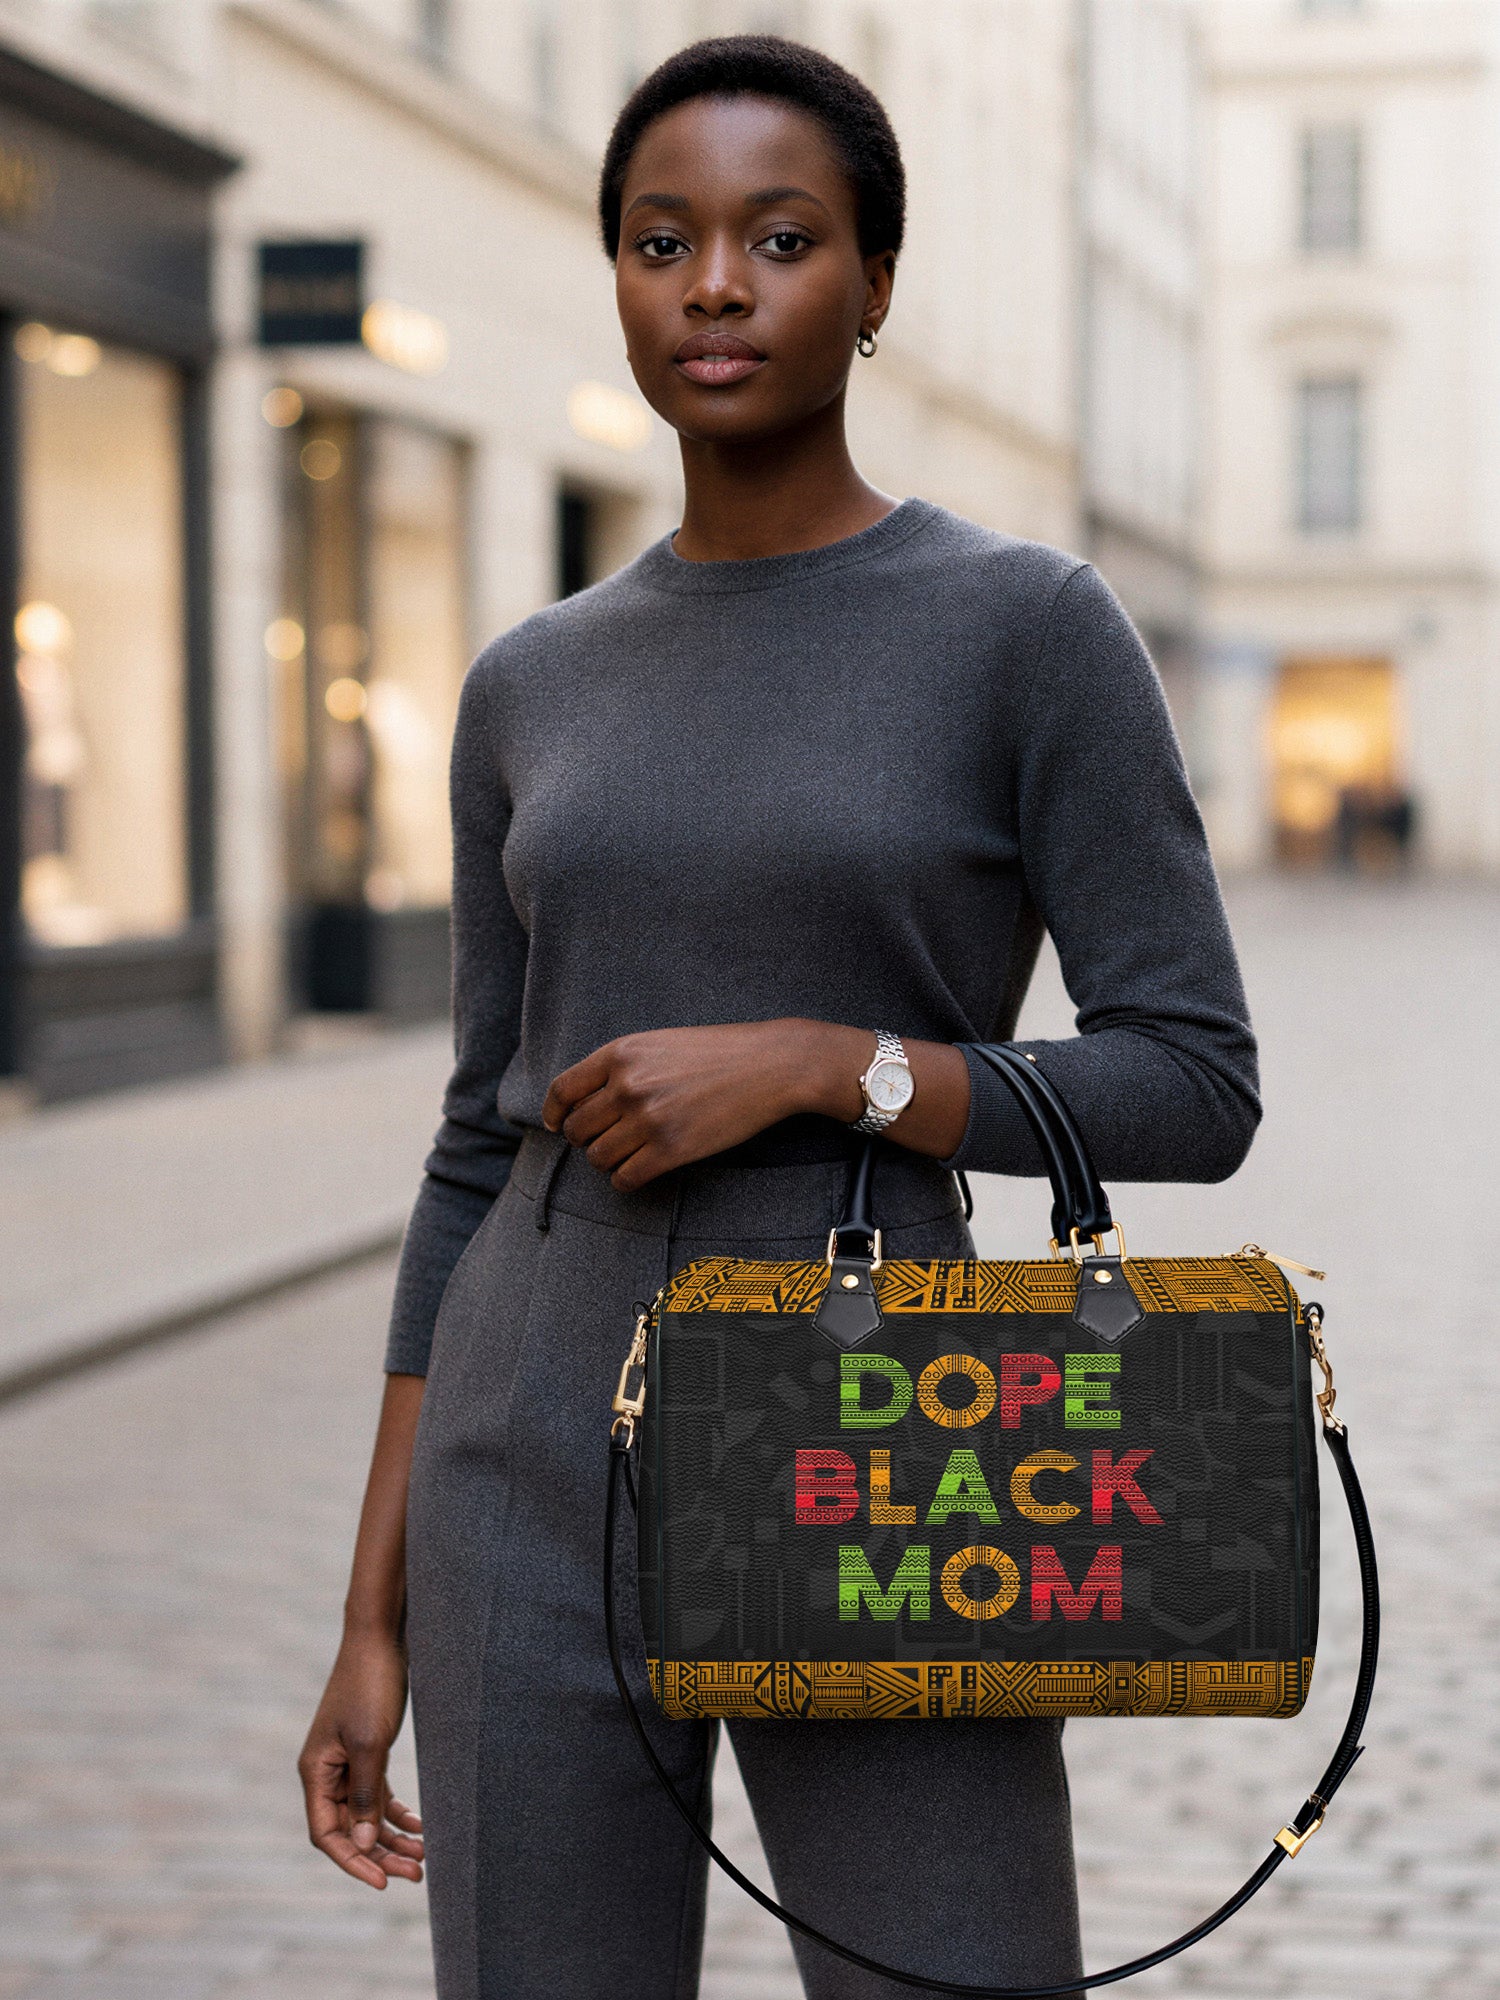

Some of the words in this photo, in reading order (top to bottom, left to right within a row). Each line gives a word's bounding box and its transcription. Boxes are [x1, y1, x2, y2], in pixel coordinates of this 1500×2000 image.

[839, 1353, 1122, 1429] DOPE
[795, 1449, 1164, 1525] BLACK
[838, 1545, 1123, 1621] MOM
